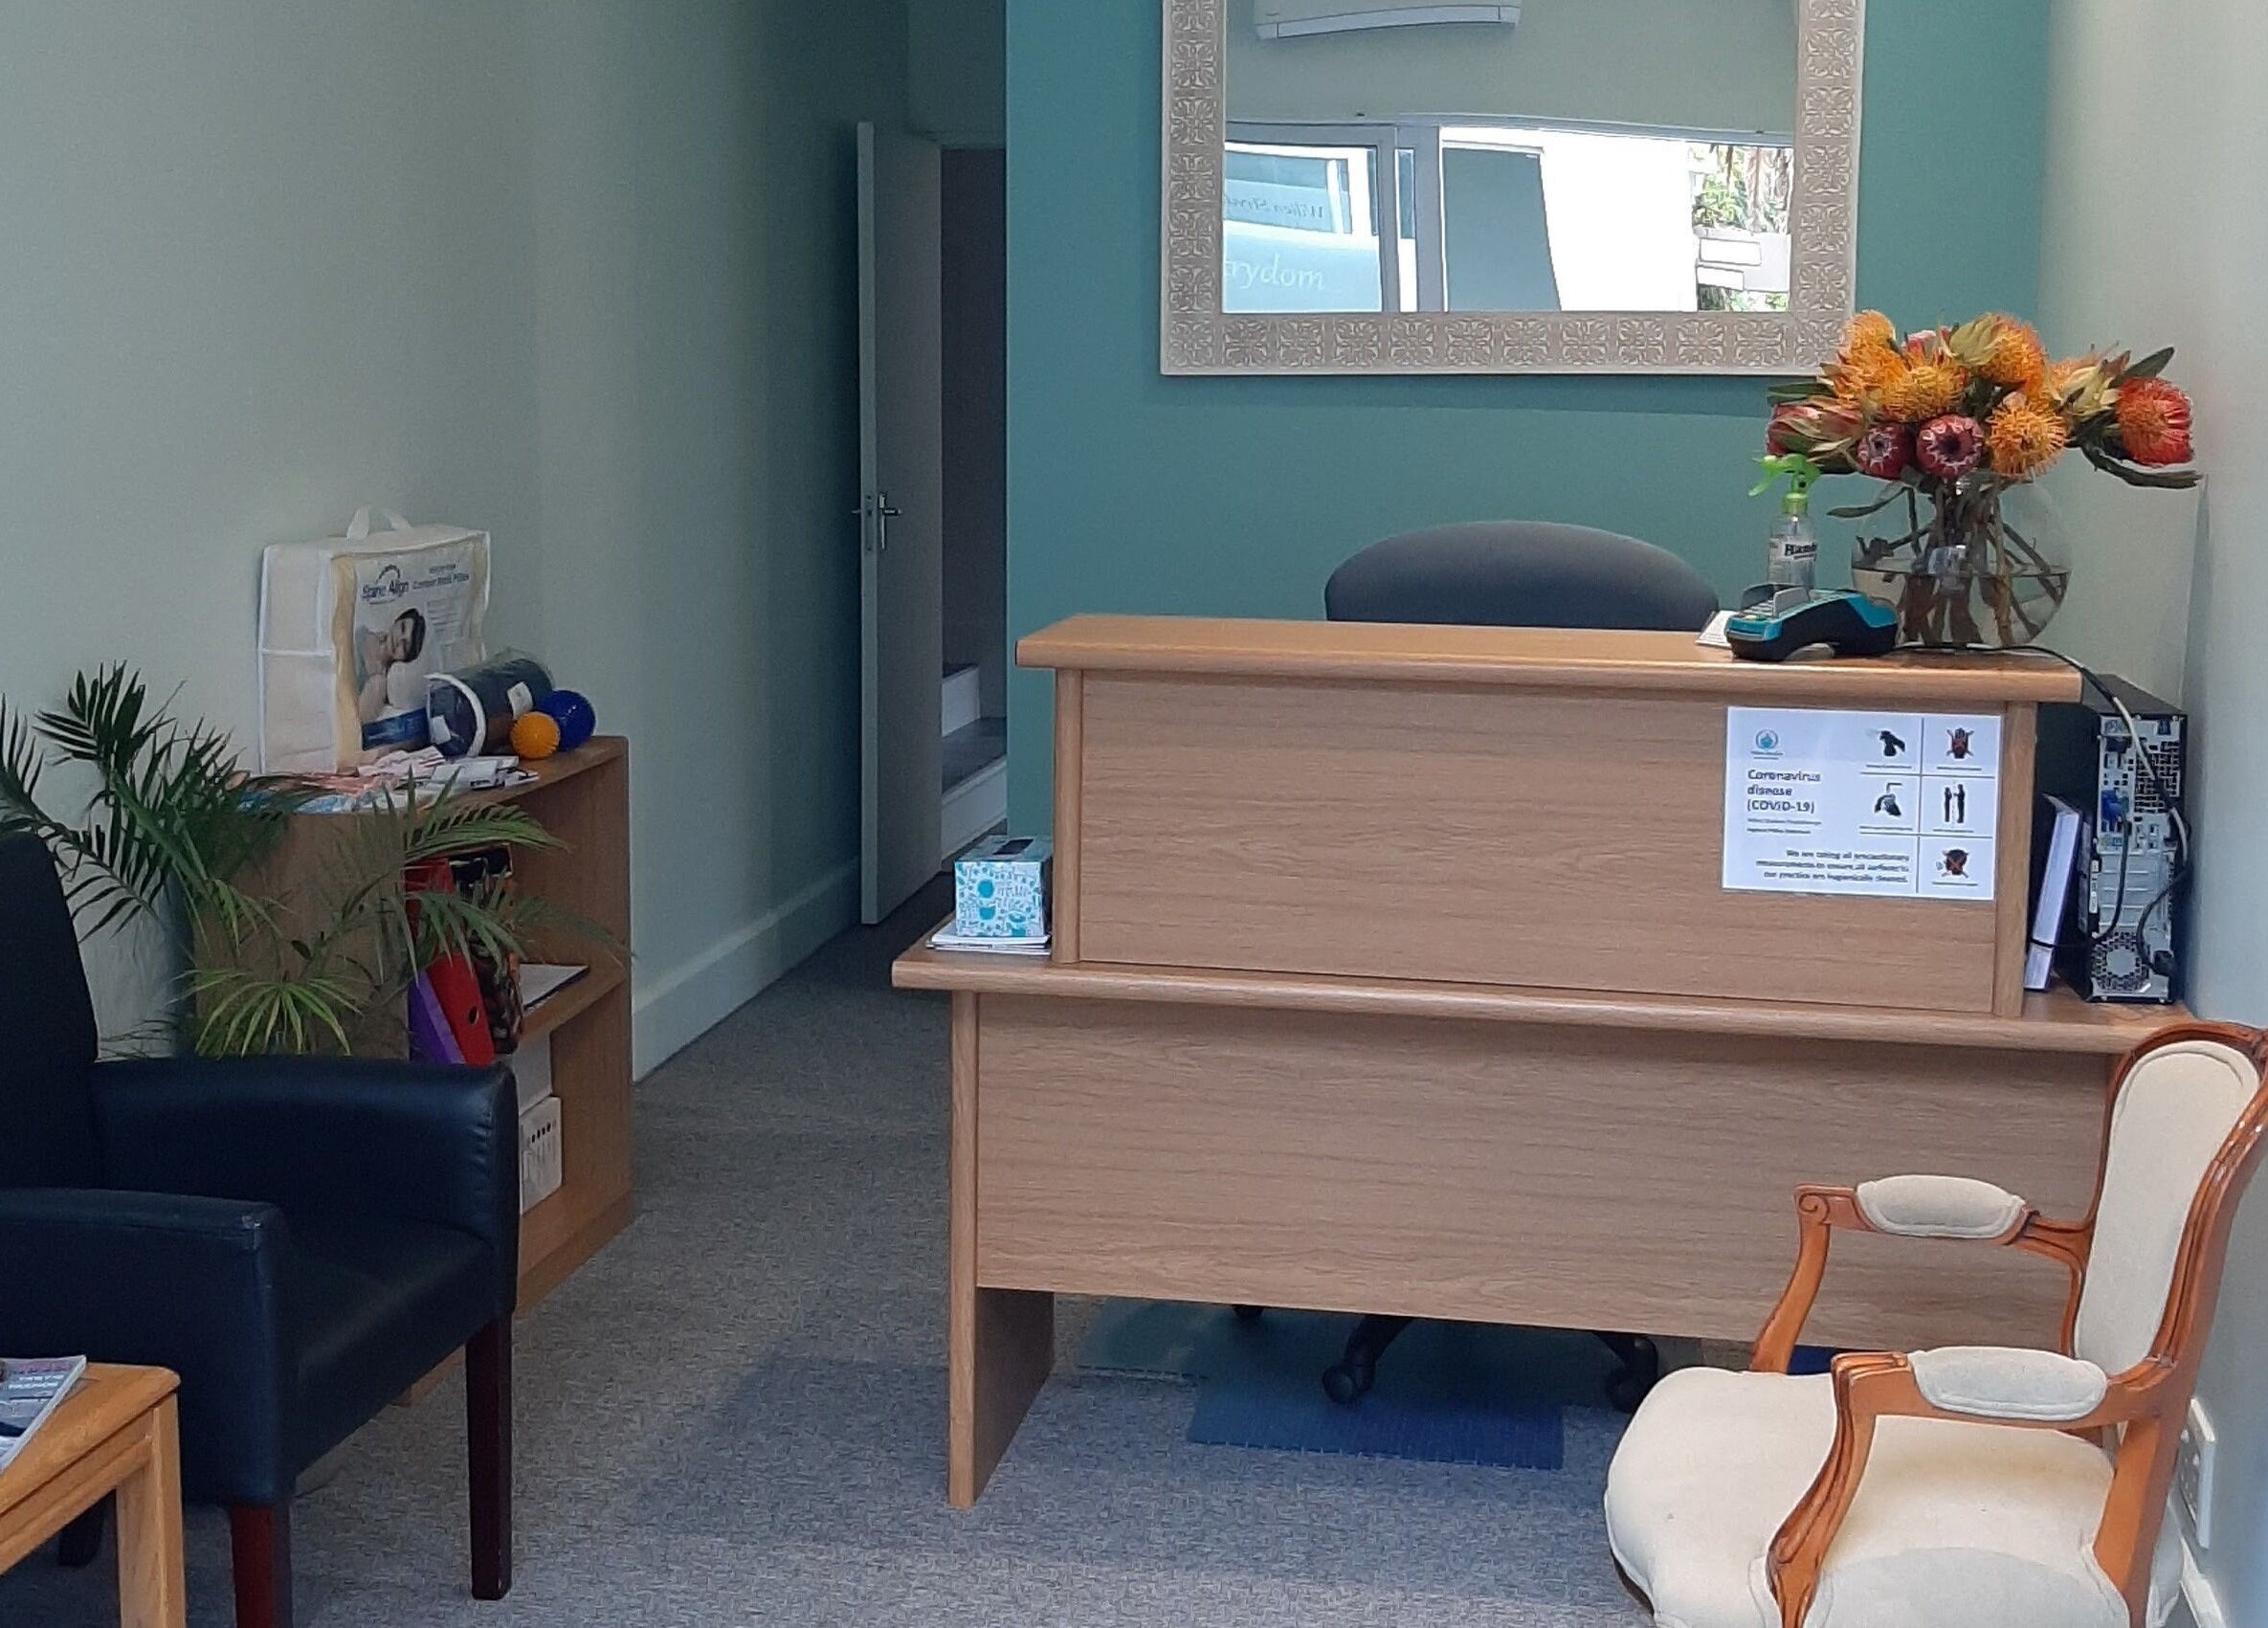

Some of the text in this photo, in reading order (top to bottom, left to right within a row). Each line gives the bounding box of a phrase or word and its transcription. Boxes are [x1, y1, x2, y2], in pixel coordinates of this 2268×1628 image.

[1747, 769, 1822, 783] Coronavirus
[1747, 784, 1792, 796] disease
[1747, 799, 1815, 814] (COVID-19)
